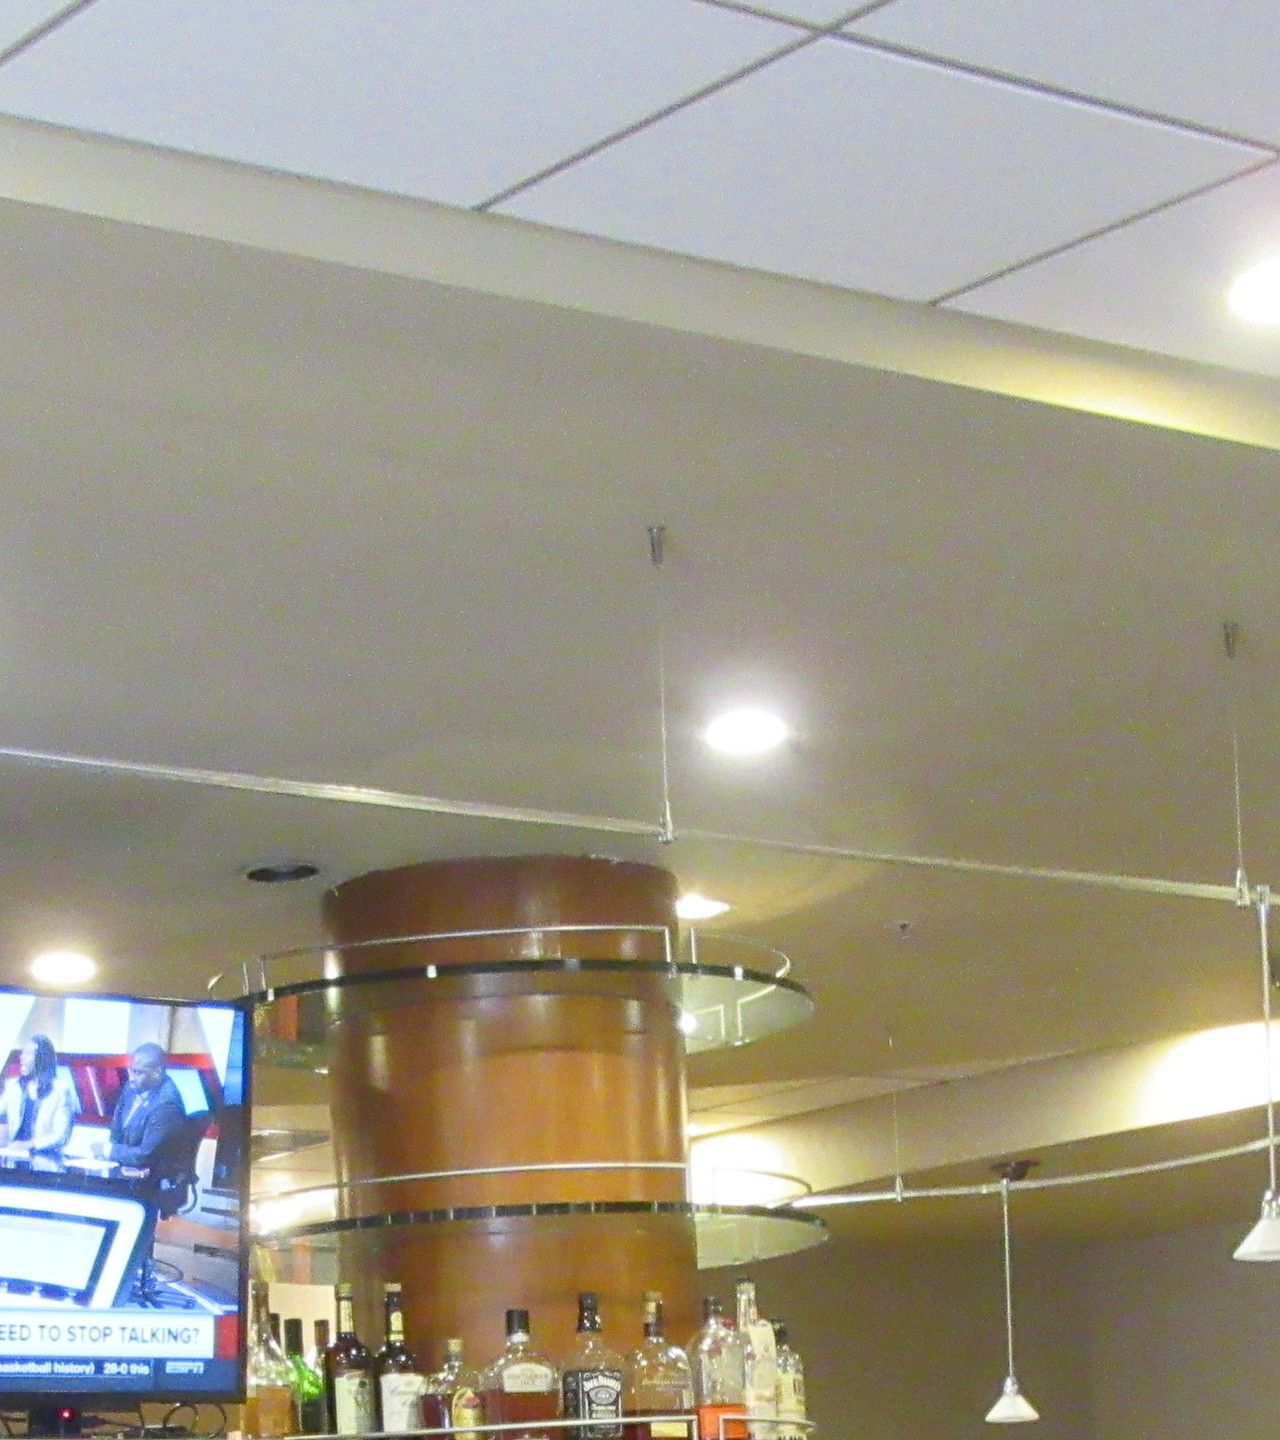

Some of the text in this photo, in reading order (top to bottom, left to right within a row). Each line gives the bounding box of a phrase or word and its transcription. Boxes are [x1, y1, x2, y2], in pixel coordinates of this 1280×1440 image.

[38, 1324, 62, 1343] TO
[66, 1324, 113, 1344] STOP
[119, 1326, 201, 1345] TALKING?
[54, 1361, 95, 1376] history)
[129, 1362, 151, 1376] this
[165, 1361, 205, 1375] ESPN
